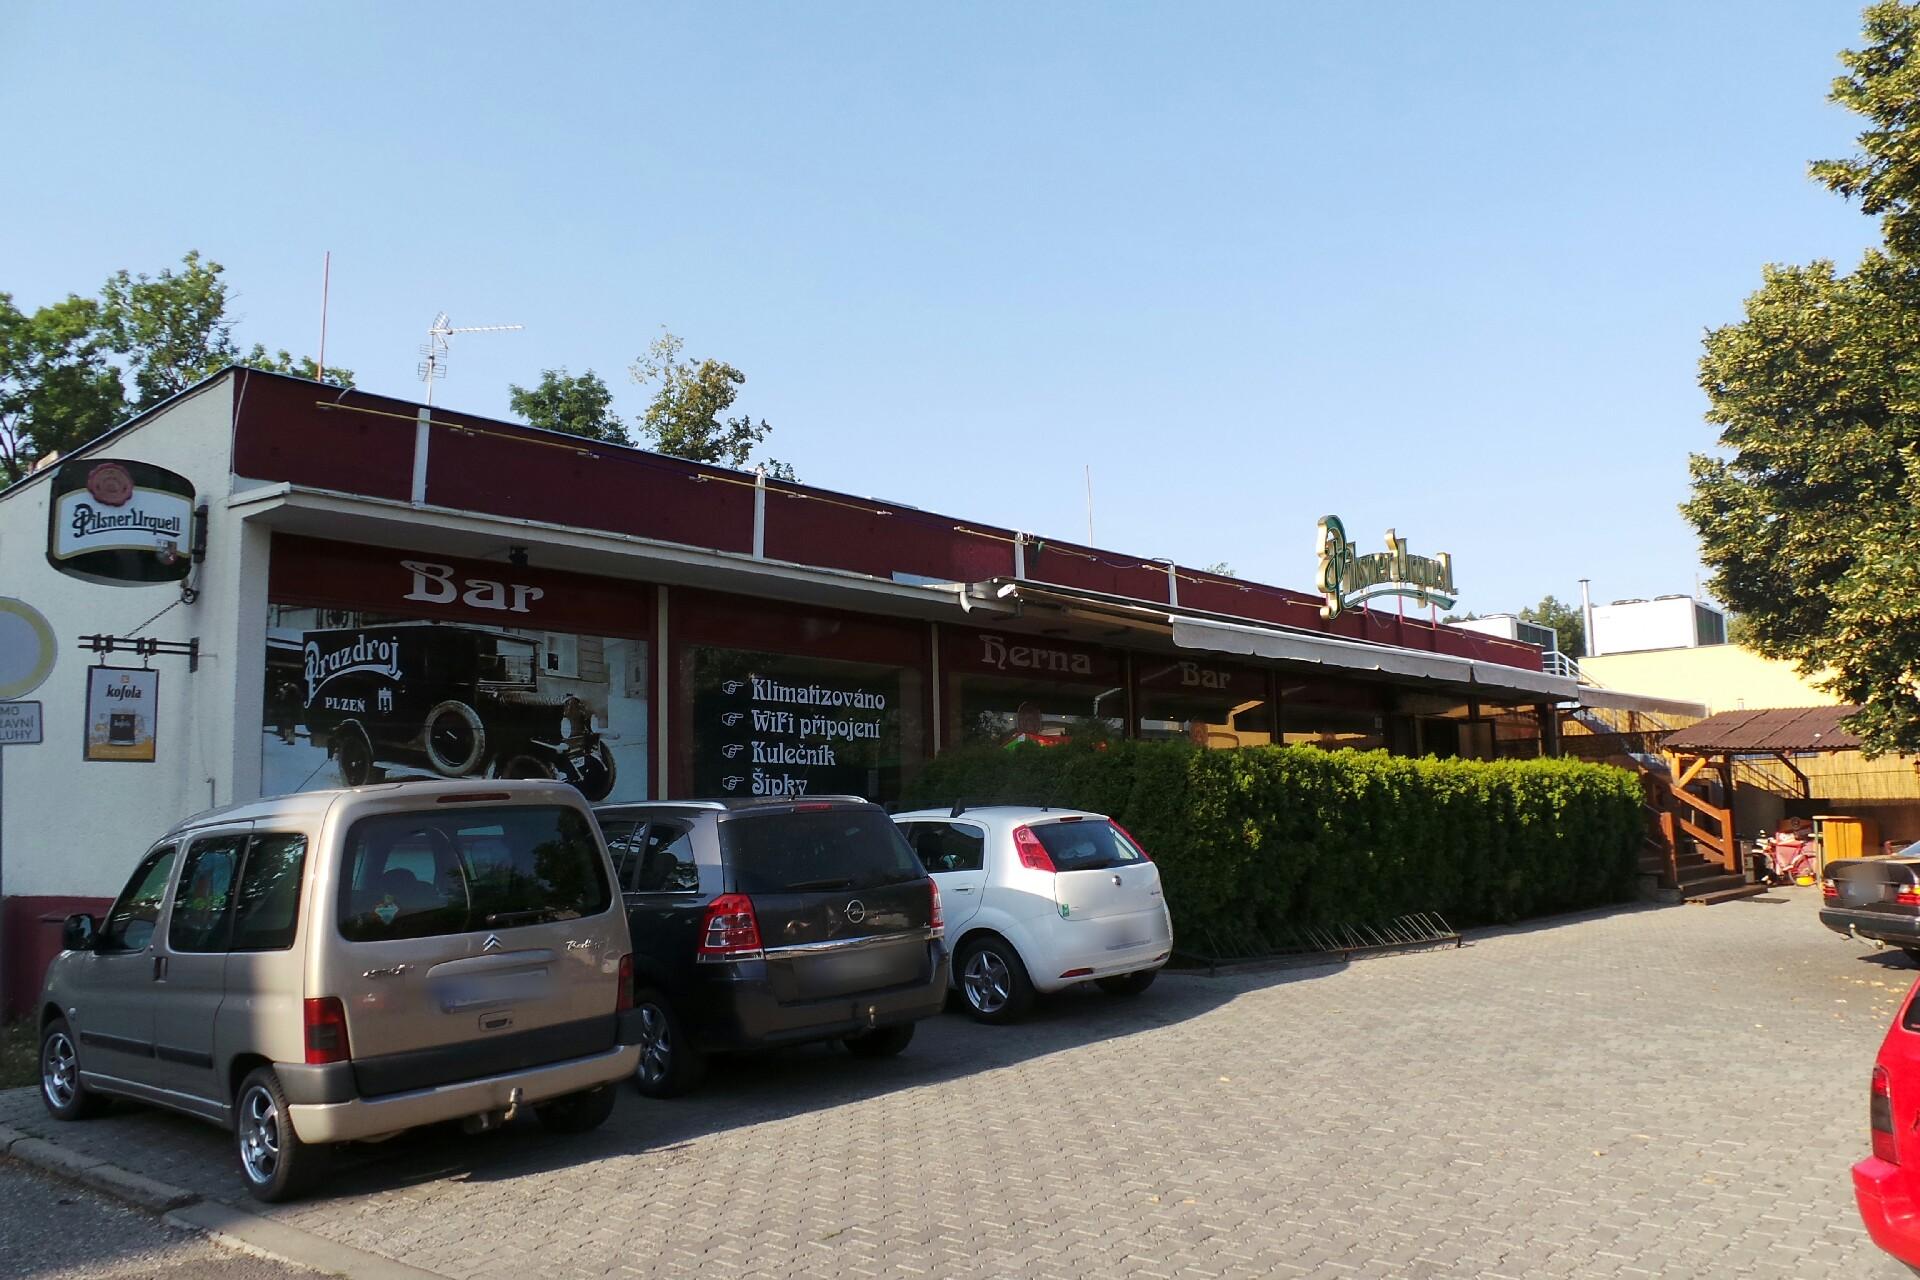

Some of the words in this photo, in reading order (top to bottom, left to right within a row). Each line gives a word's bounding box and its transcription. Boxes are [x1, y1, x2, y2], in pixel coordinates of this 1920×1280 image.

[72, 503, 132, 538] Pilsner
[131, 507, 180, 535] Urquell
[400, 559, 544, 613] Bar
[979, 634, 1093, 674] Herna
[303, 634, 399, 709] Prazdroj
[1178, 661, 1231, 689] Bar
[106, 684, 142, 701] kofola
[751, 678, 886, 711] Klimatizováno
[751, 709, 794, 734] WiFi
[800, 714, 881, 741] připojení
[751, 741, 836, 766] Kulečník
[751, 768, 808, 797] Šipky
